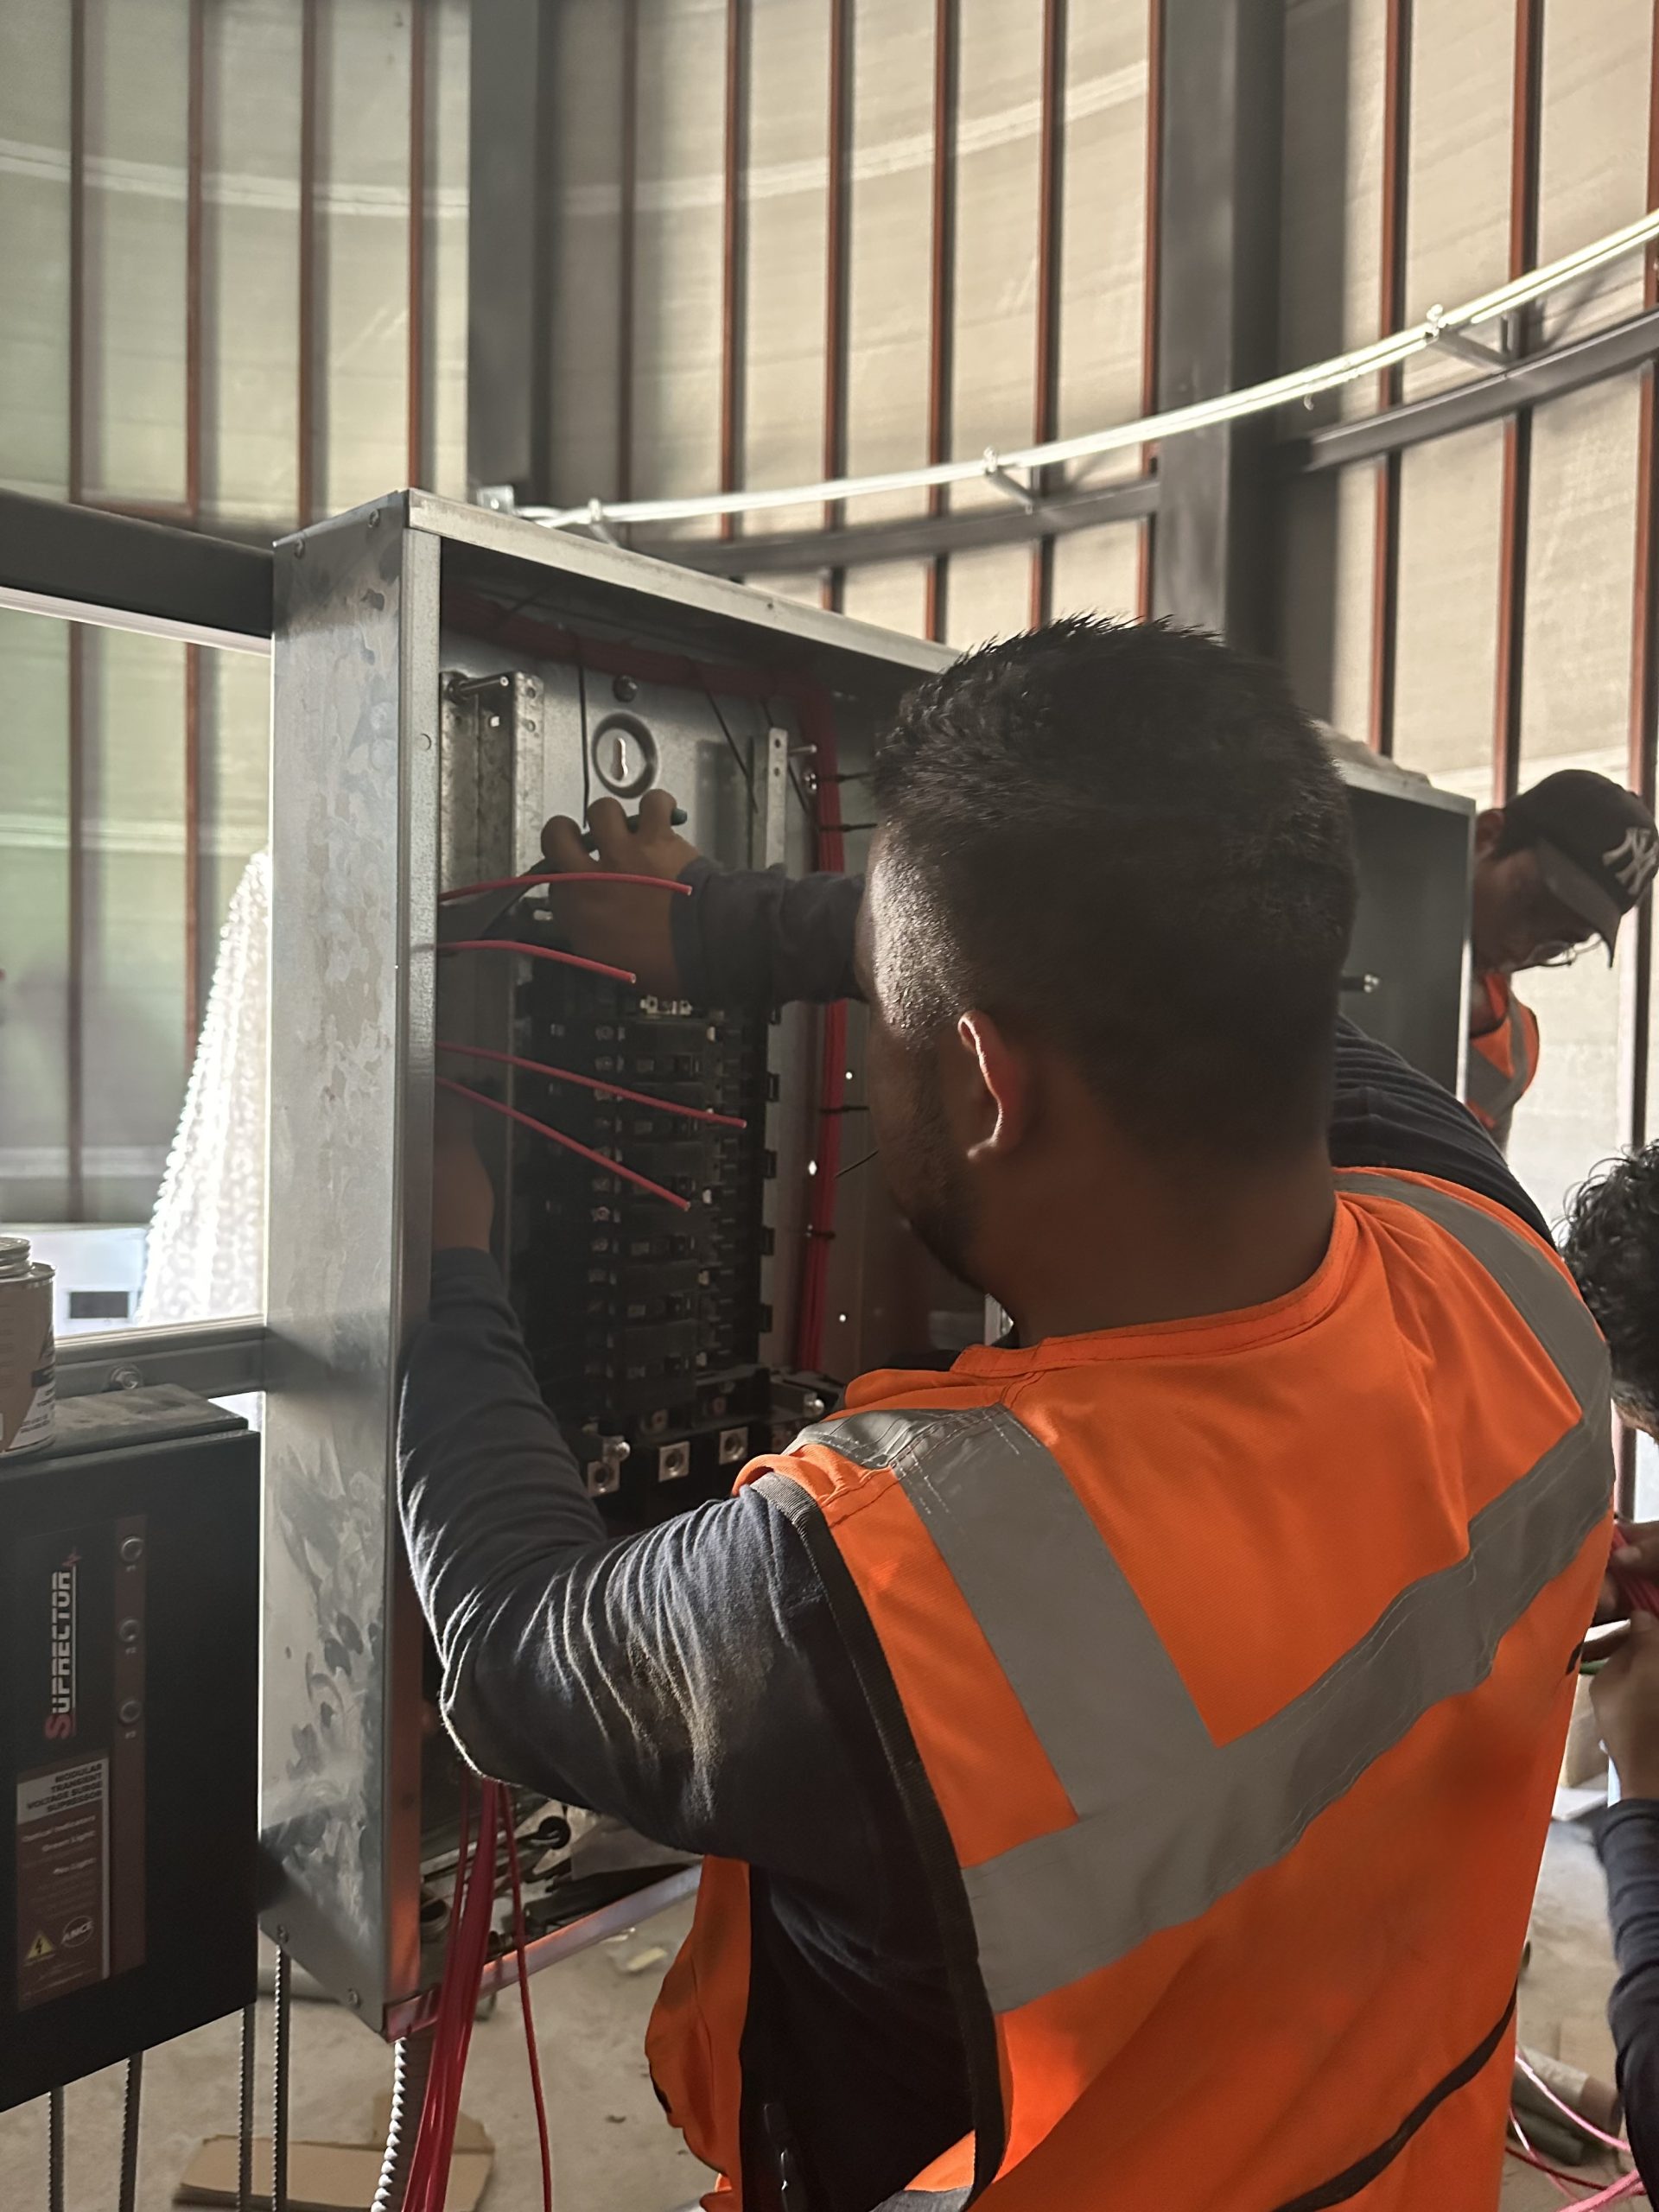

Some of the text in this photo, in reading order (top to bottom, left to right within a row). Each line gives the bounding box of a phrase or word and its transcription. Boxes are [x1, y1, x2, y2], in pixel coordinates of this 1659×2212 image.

[46, 1570, 73, 1739] SUPRECTOR
[27, 1781, 102, 1809] VOLTAGE SURGE
